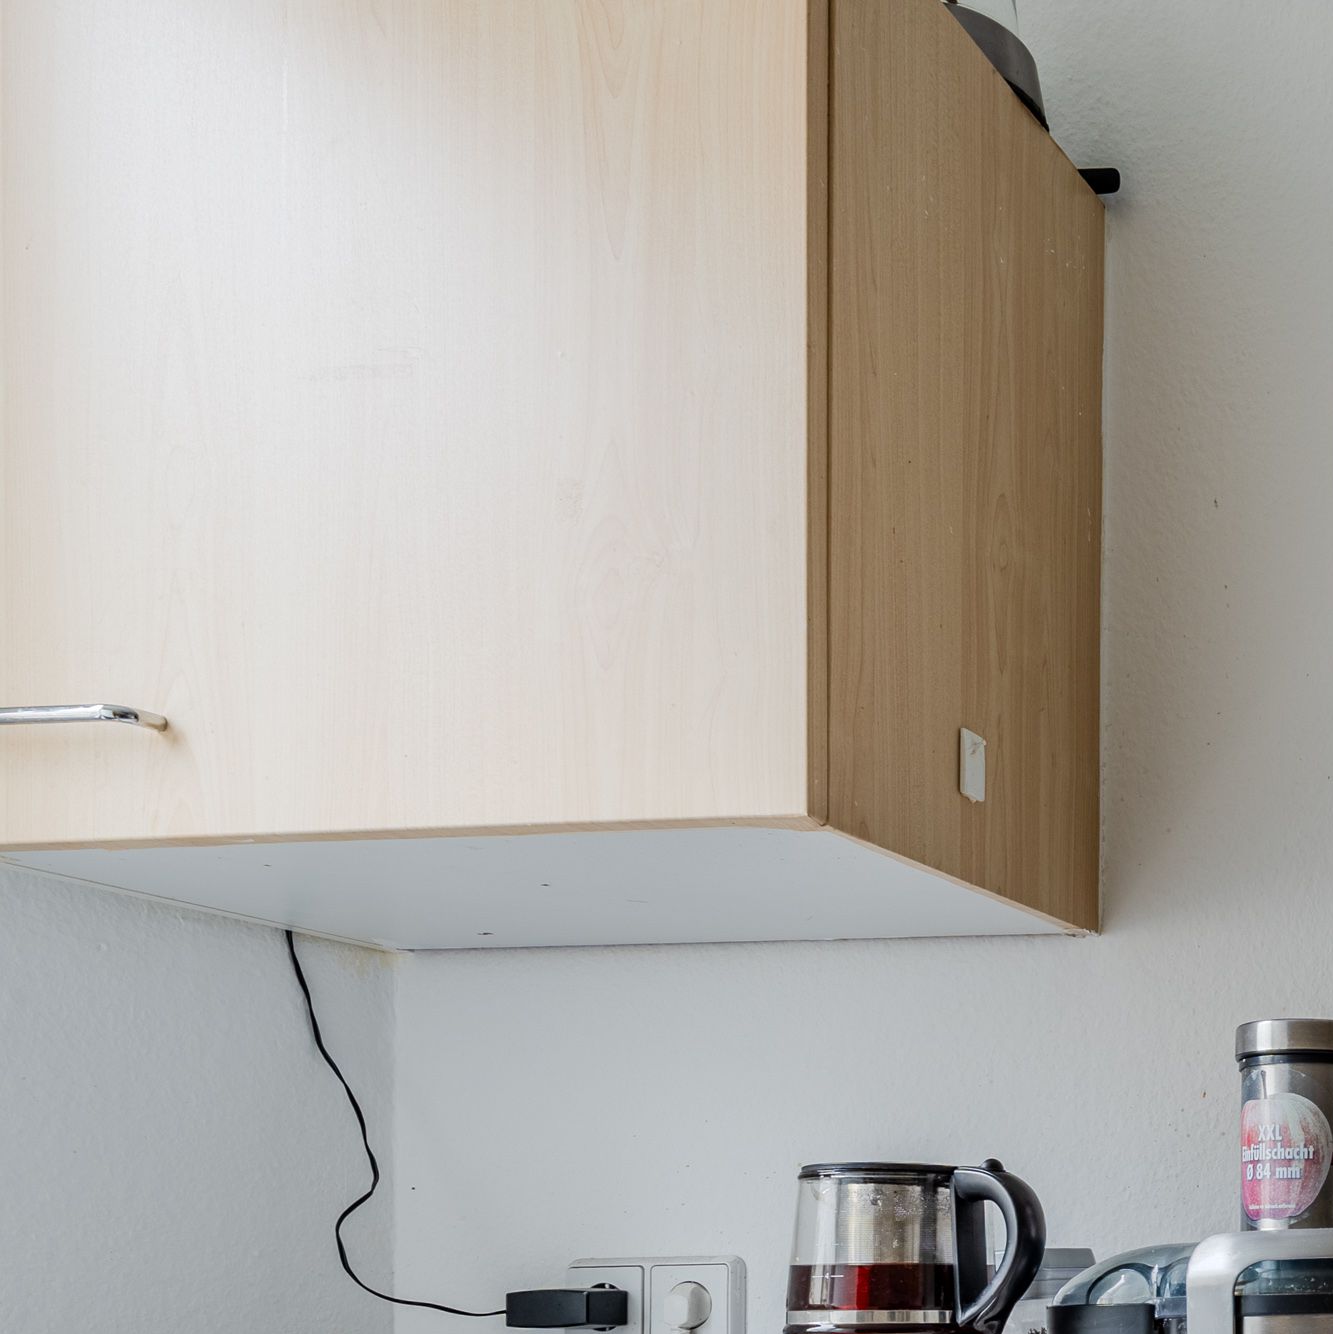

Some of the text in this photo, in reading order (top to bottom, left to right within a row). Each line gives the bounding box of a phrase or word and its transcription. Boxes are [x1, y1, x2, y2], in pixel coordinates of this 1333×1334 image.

[1258, 1124, 1283, 1141] XXL
[1242, 1142, 1314, 1162] Einfüllschacht
[1255, 1163, 1271, 1180] 84
[1275, 1166, 1301, 1179] mm
